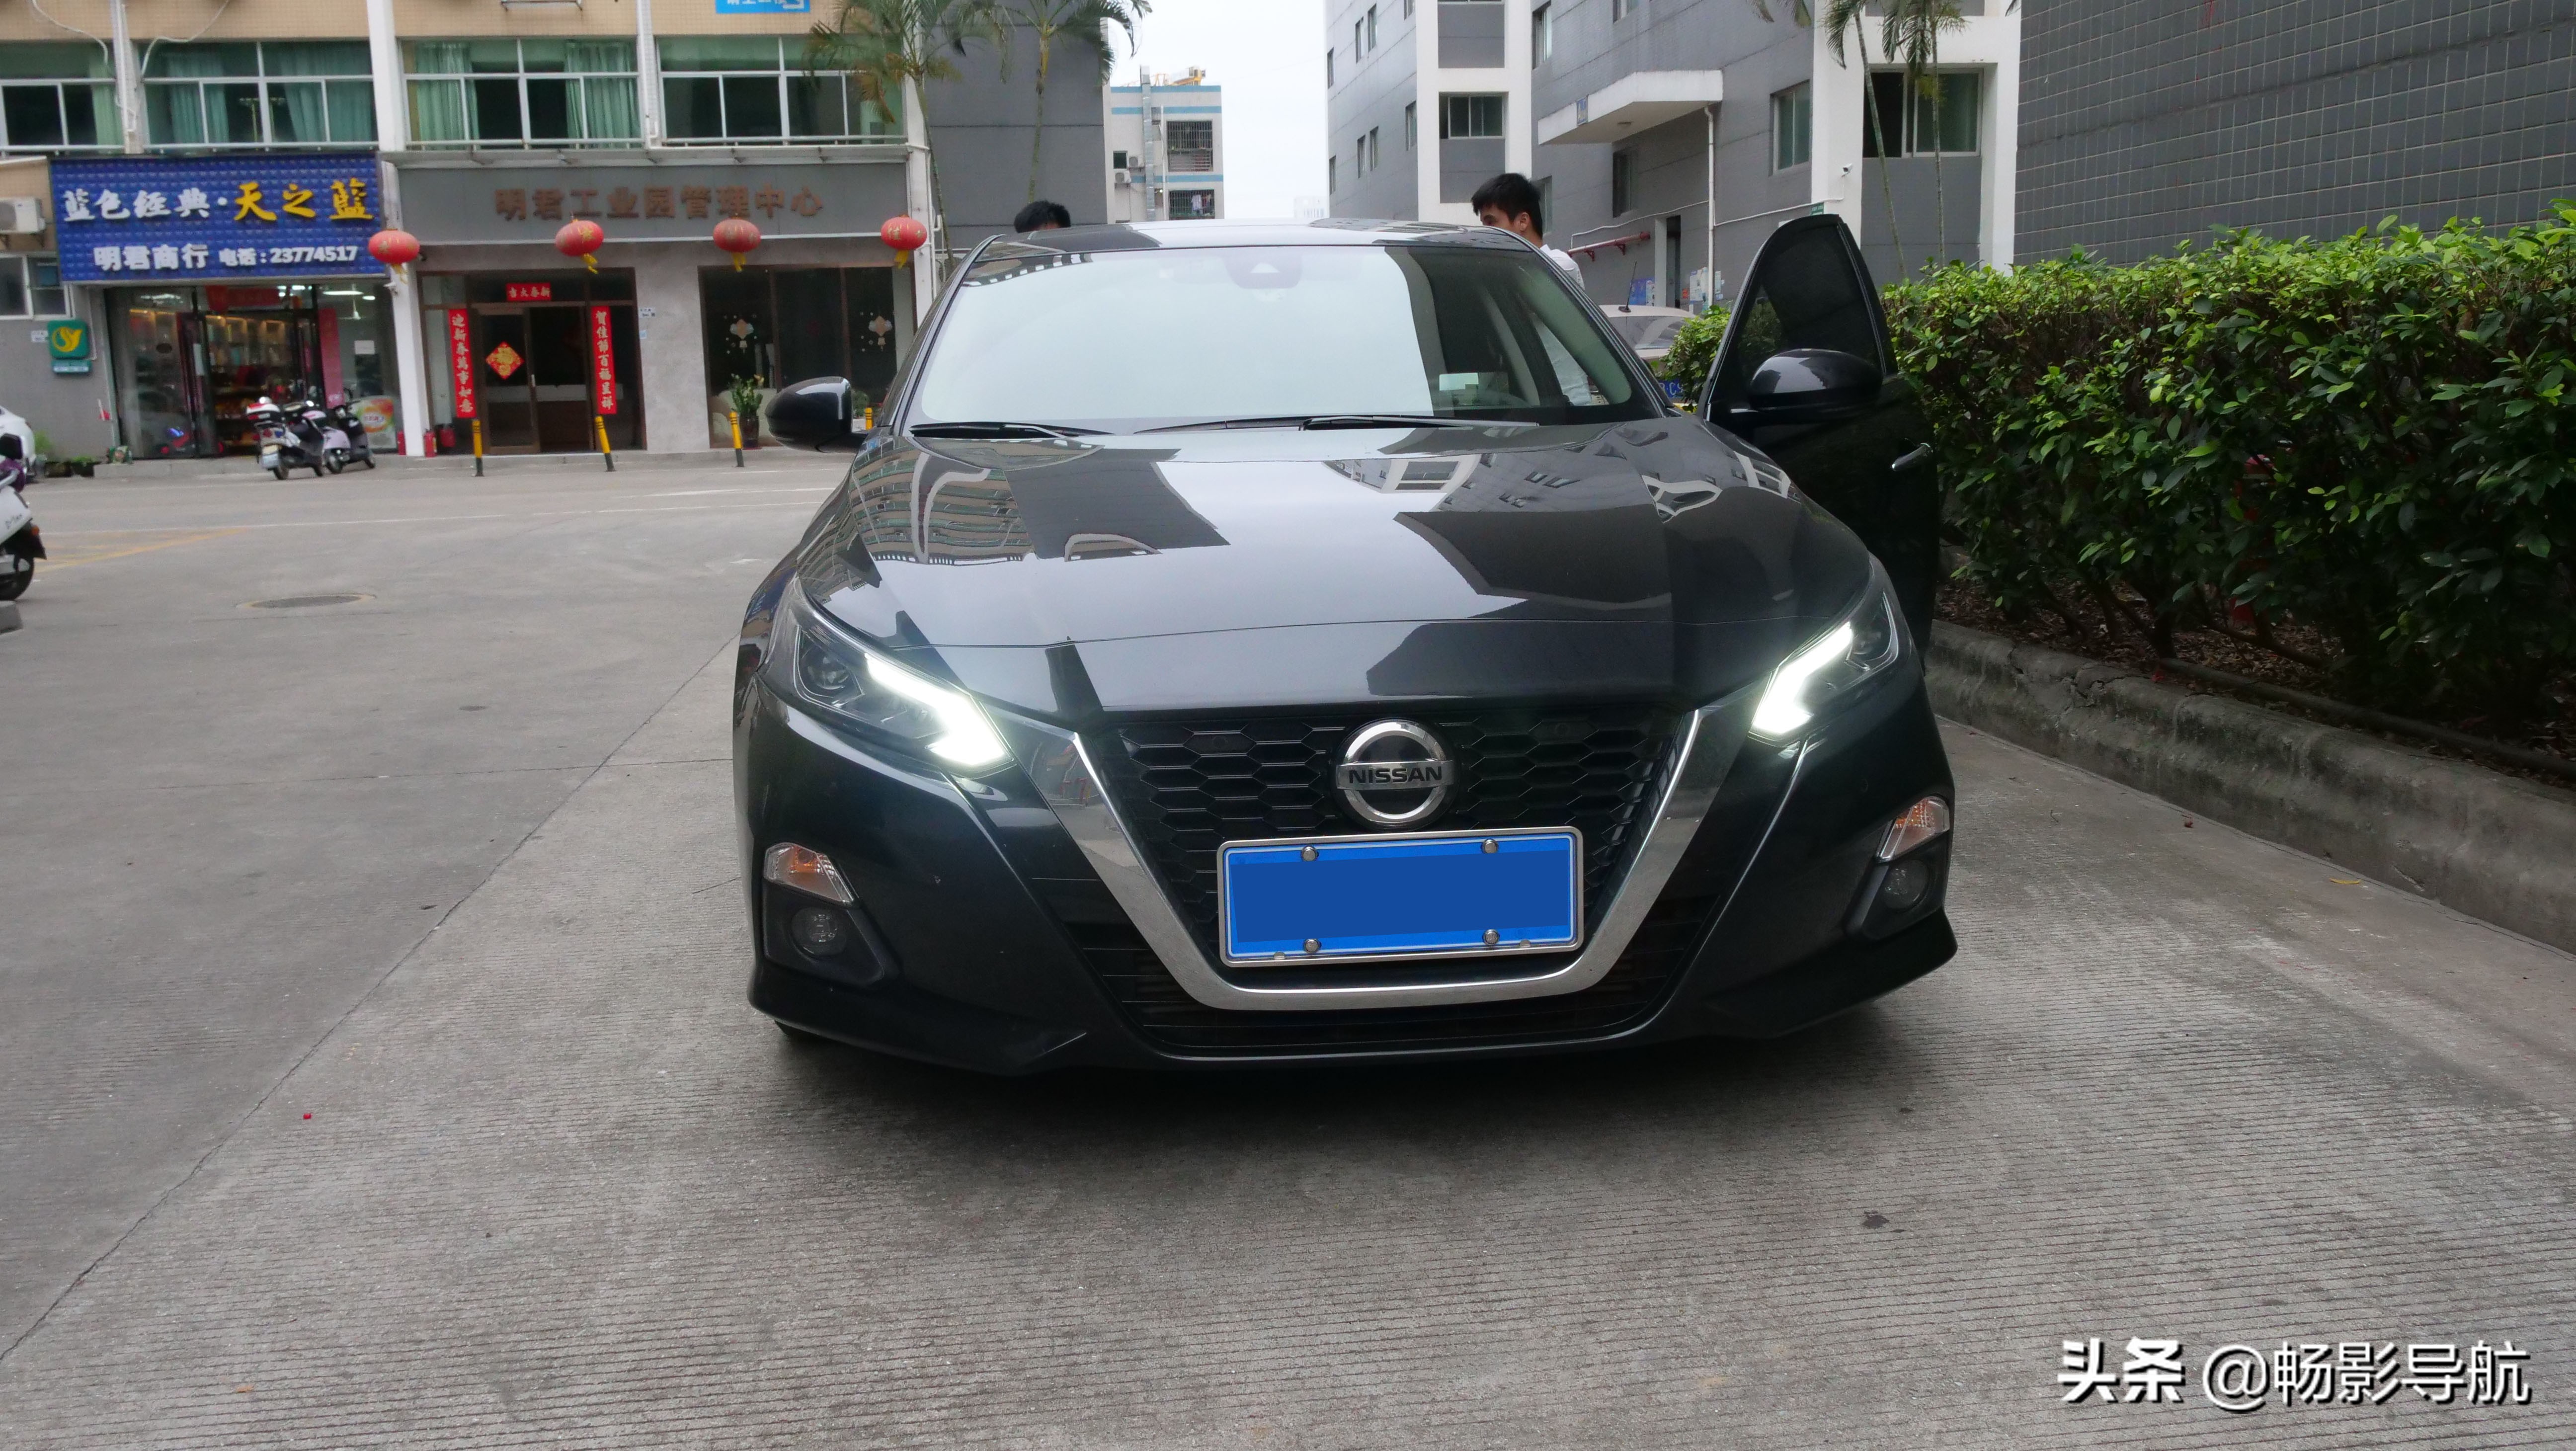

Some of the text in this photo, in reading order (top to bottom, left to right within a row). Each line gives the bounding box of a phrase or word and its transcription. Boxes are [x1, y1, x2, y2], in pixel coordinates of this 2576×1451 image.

[93, 243, 209, 271] 明君商行
[1348, 766, 1443, 784] NISSAN
